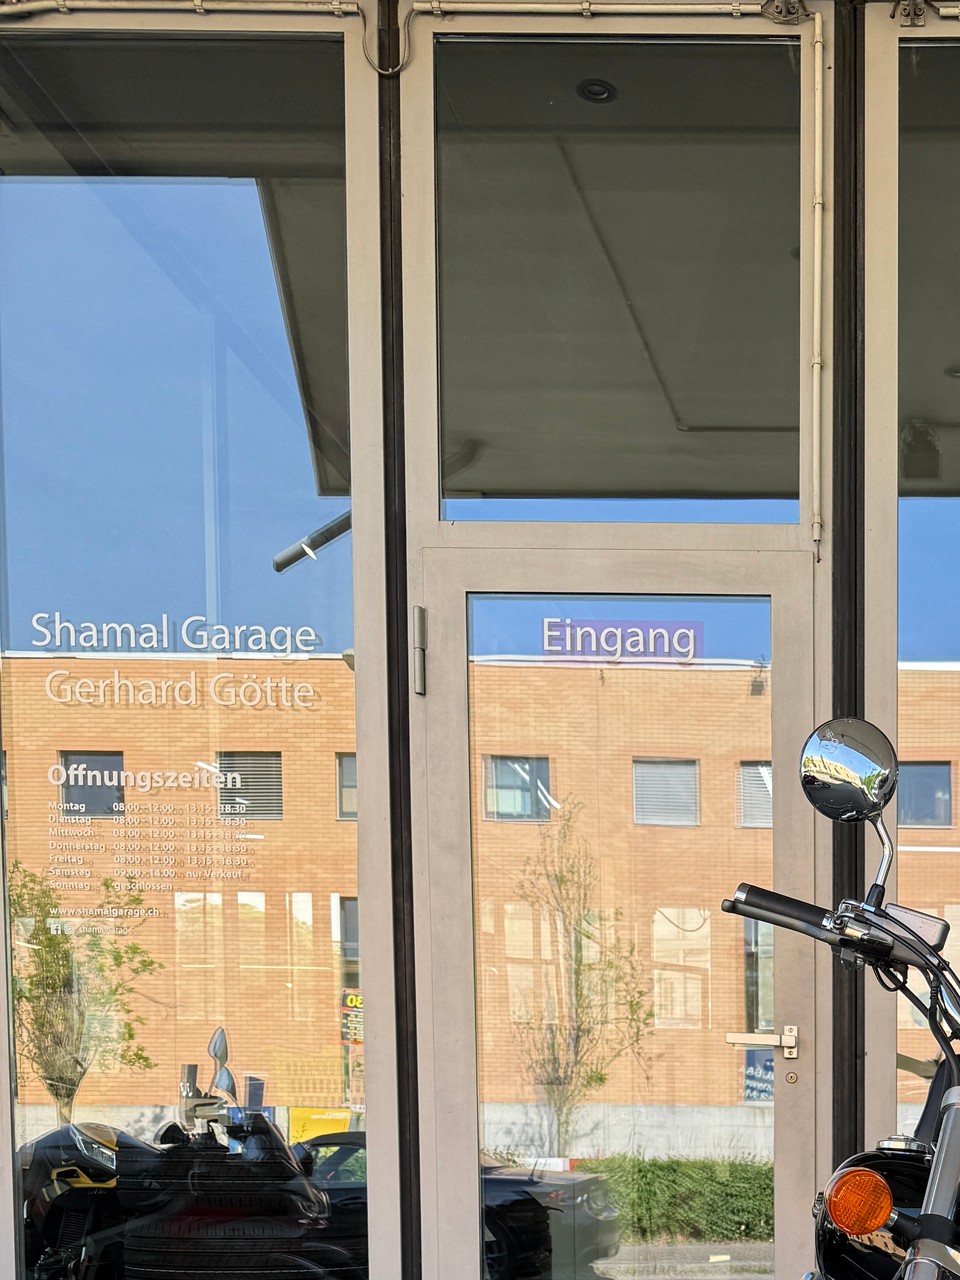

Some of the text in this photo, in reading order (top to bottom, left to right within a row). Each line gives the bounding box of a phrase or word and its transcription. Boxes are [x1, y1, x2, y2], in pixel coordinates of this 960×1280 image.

[31, 612, 316, 658] Shamal Garage
[543, 617, 695, 663] Eingang
[45, 670, 314, 707] Gerhard Götte
[48, 802, 86, 813] Montag
[48, 815, 92, 826] Dienstag
[48, 828, 95, 837] Mittwoch
[49, 841, 106, 852] Donnerstag
[49, 854, 84, 864] Freitag
[50, 867, 91, 877] Samstag
[204, 870, 242, 878] Verkauf
[50, 880, 173, 891] Sonntag geschlossen
[49, 907, 159, 917] www.shamalgarage.ch
